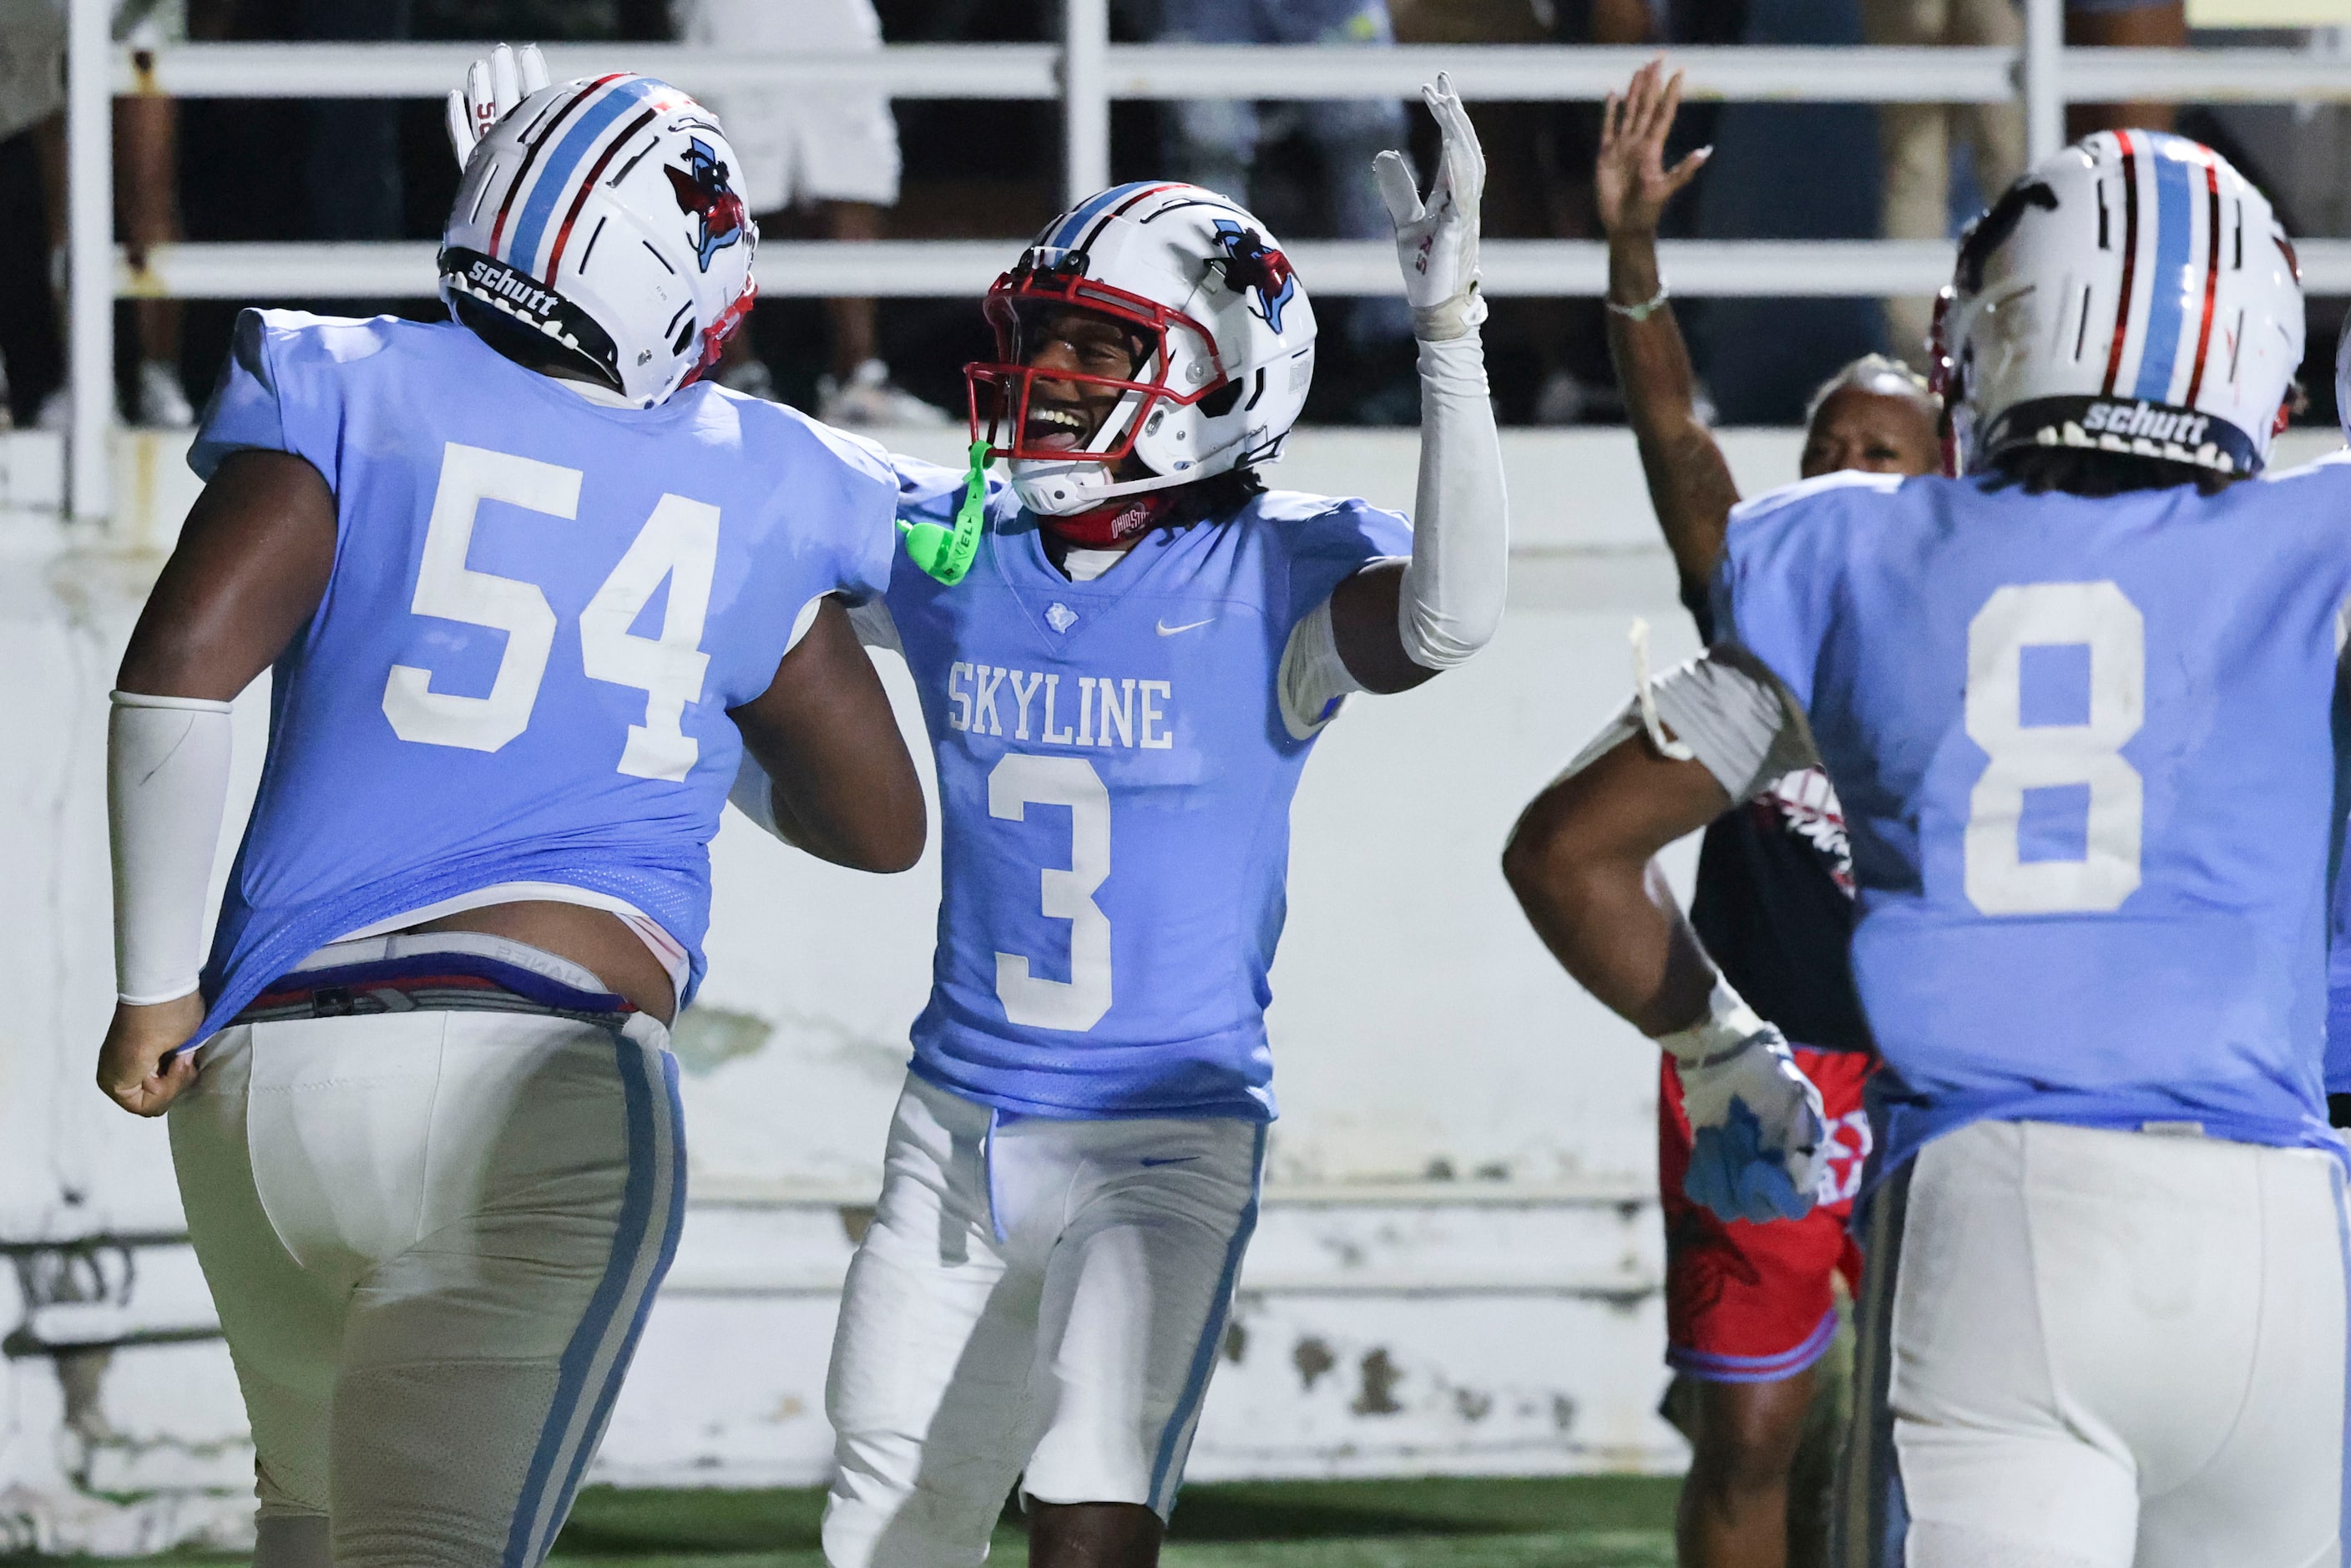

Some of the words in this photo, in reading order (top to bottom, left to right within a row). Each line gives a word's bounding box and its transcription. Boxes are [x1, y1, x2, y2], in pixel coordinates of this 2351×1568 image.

[468, 260, 559, 316] schutt
[2083, 401, 2208, 445] schutt
[382, 441, 721, 783] 54
[948, 661, 1173, 749] SKYLINE
[1964, 580, 2144, 916] 8
[988, 752, 1113, 1032] 3
